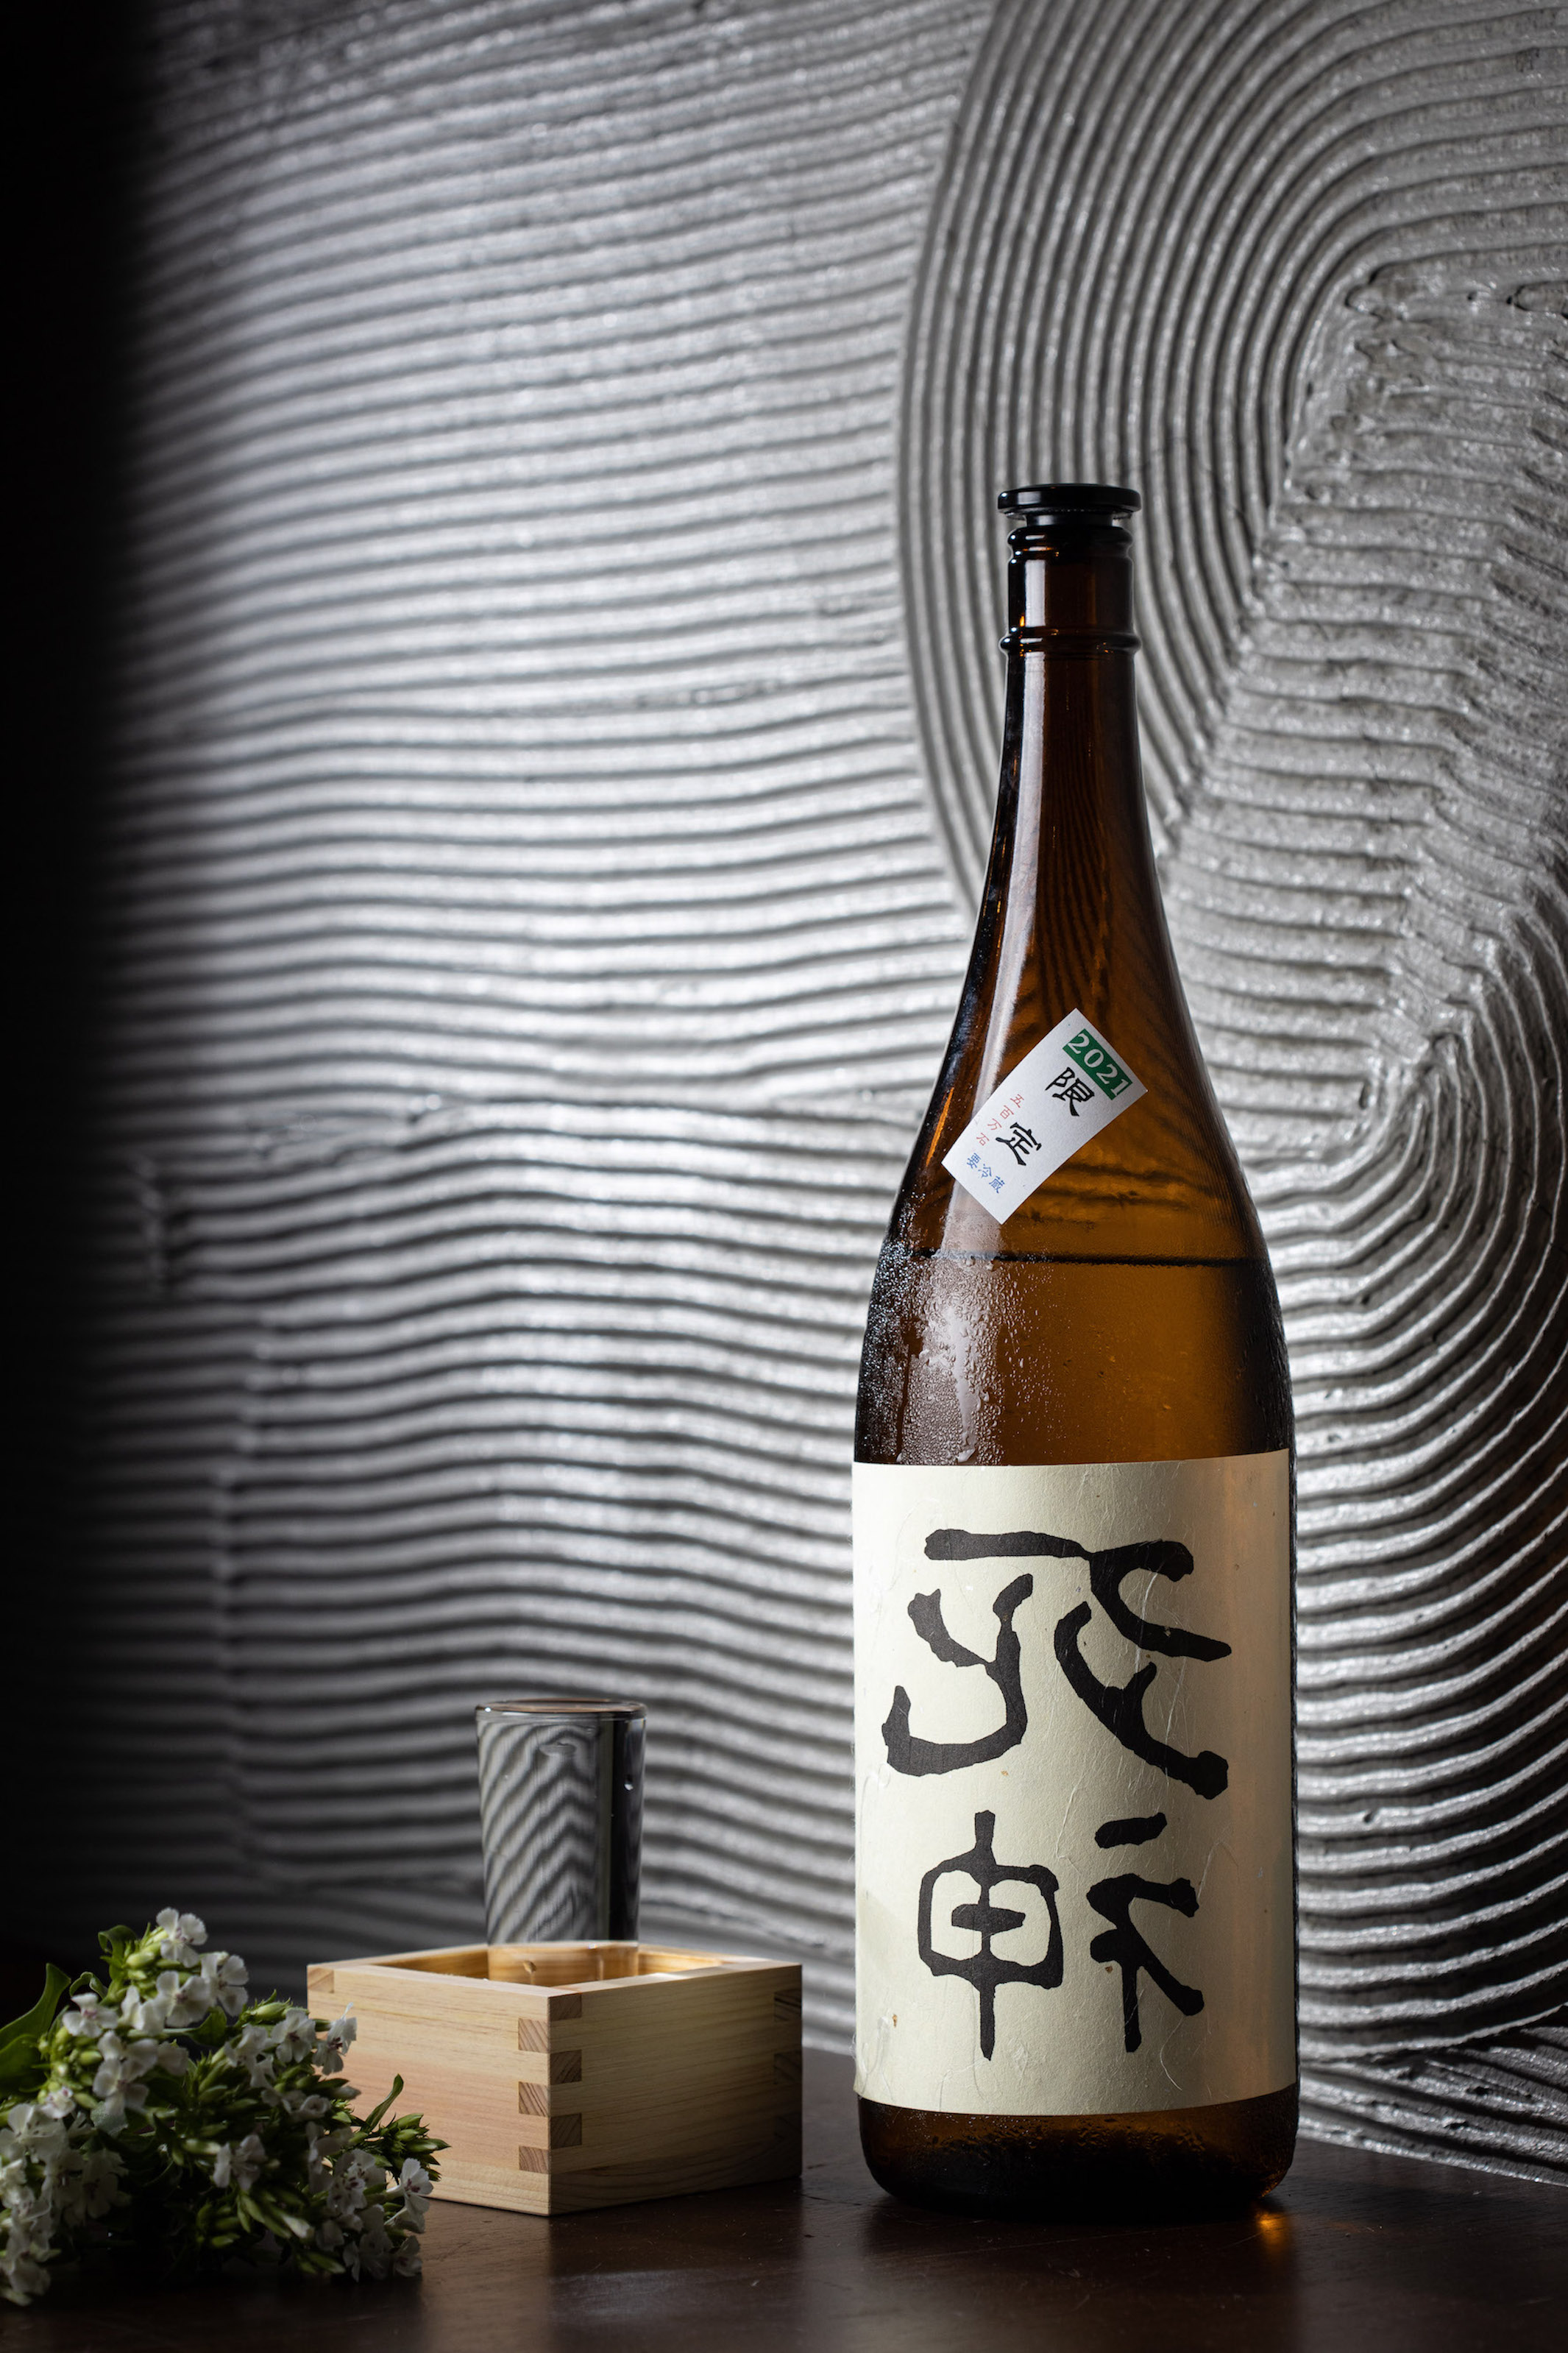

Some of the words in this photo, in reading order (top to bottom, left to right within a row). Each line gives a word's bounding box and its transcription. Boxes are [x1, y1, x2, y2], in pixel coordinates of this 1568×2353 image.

[1067, 1033, 1129, 1097] 2021
[976, 1094, 1025, 1147] 五百万石
[995, 1066, 1095, 1167] 限定
[966, 1153, 1006, 1194] 要冷蔵
